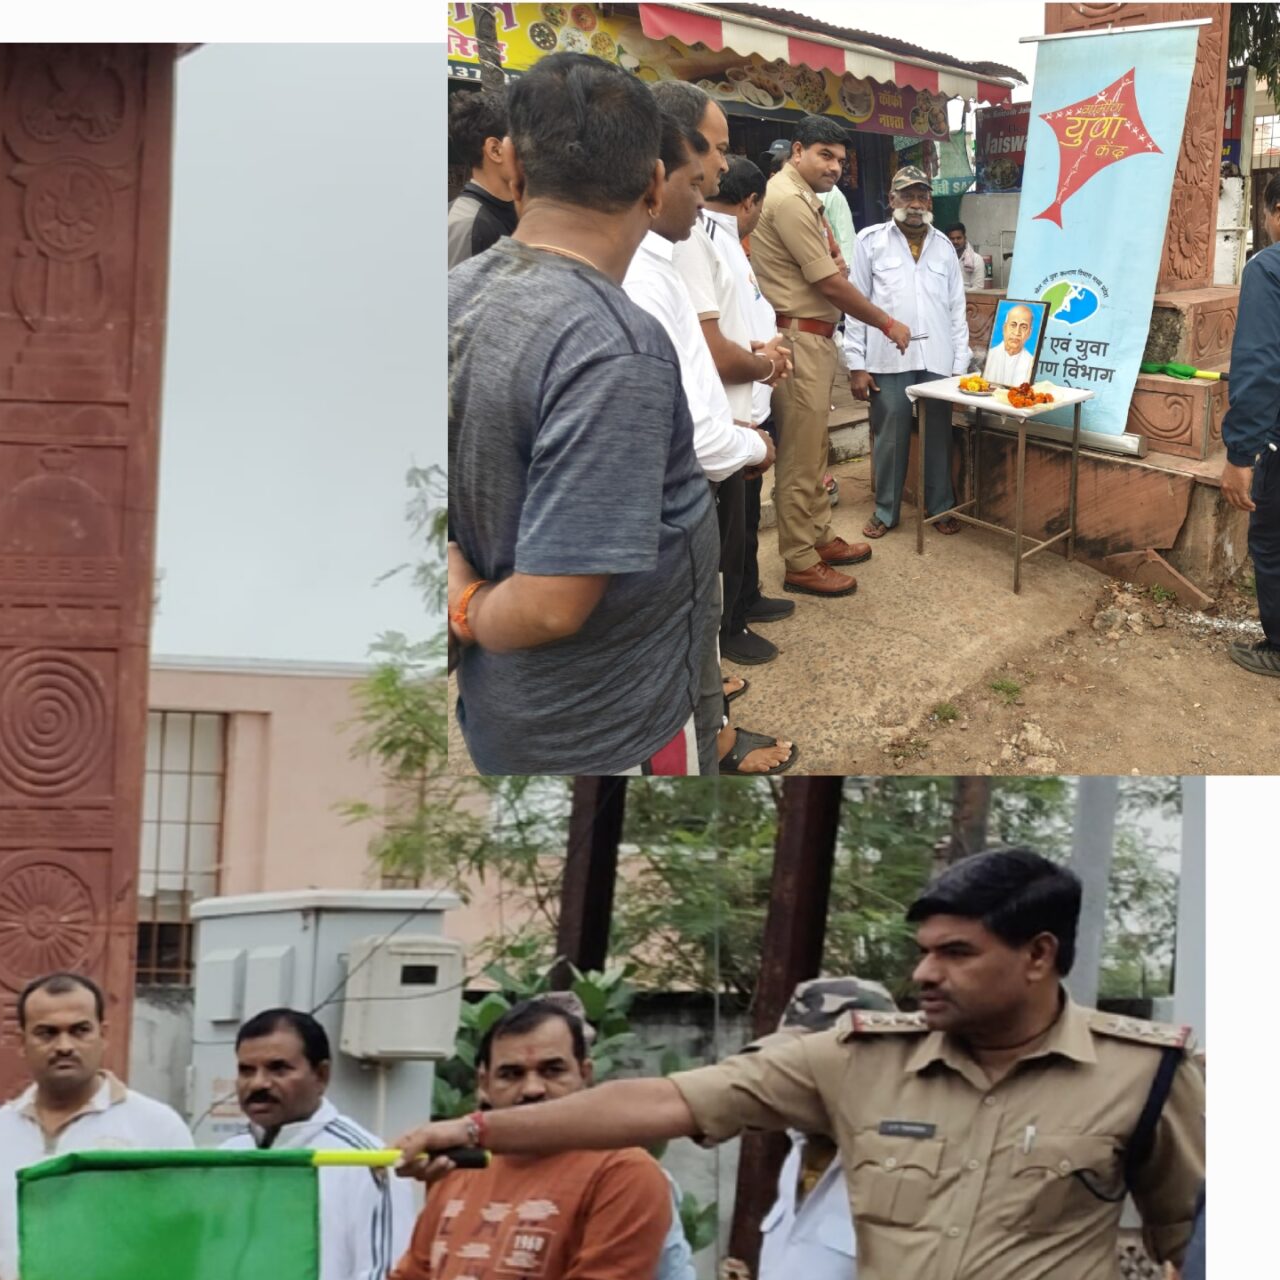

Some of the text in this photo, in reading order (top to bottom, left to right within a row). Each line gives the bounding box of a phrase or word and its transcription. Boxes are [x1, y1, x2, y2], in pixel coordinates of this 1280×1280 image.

[1059, 116, 1128, 147] युवा
[1050, 332, 1072, 355] एवं
[1076, 339, 1110, 361] युवा
[1063, 357, 1116, 383] विभाग
